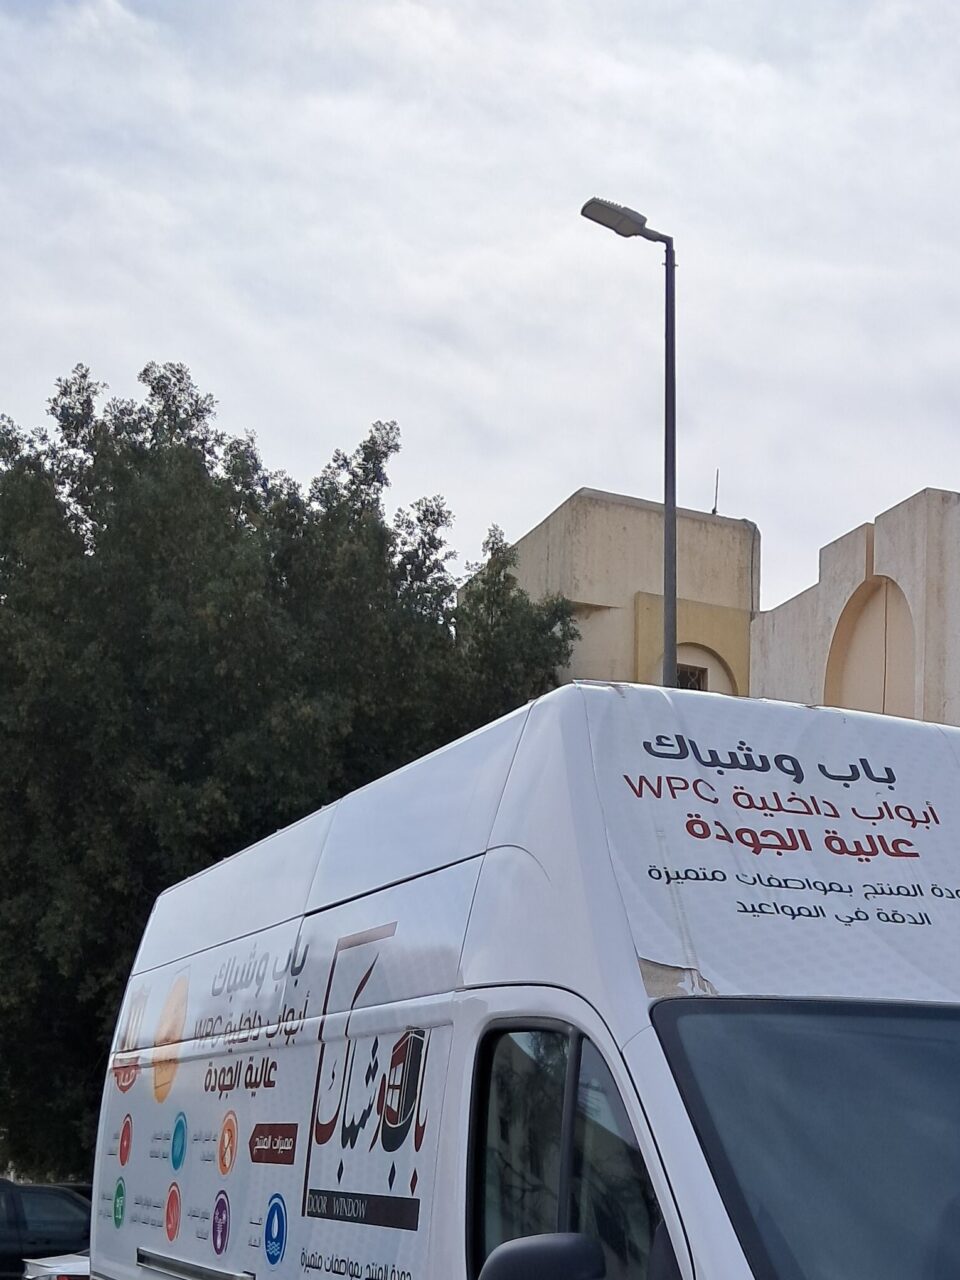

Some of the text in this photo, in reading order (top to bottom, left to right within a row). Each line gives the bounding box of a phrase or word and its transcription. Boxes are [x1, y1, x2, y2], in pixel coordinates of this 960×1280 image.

[642, 734, 897, 791] باب وشباك
[623, 774, 941, 830] أبواب داخلية WPC
[685, 812, 920, 863] عالية الجودة
[647, 864, 727, 885] متميزة
[735, 872, 854, 896] بمواصفات
[862, 882, 925, 902] المنتج
[736, 899, 932, 927] الدقة في المواعيد
[211, 934, 310, 1003] باب وشباك
[266, 990, 311, 1046] أبواب
[204, 1056, 278, 1100] عالية الجودة
[307, 1194, 368, 1219] DOOR WINDOW
[300, 1247, 323, 1273] متميزة
